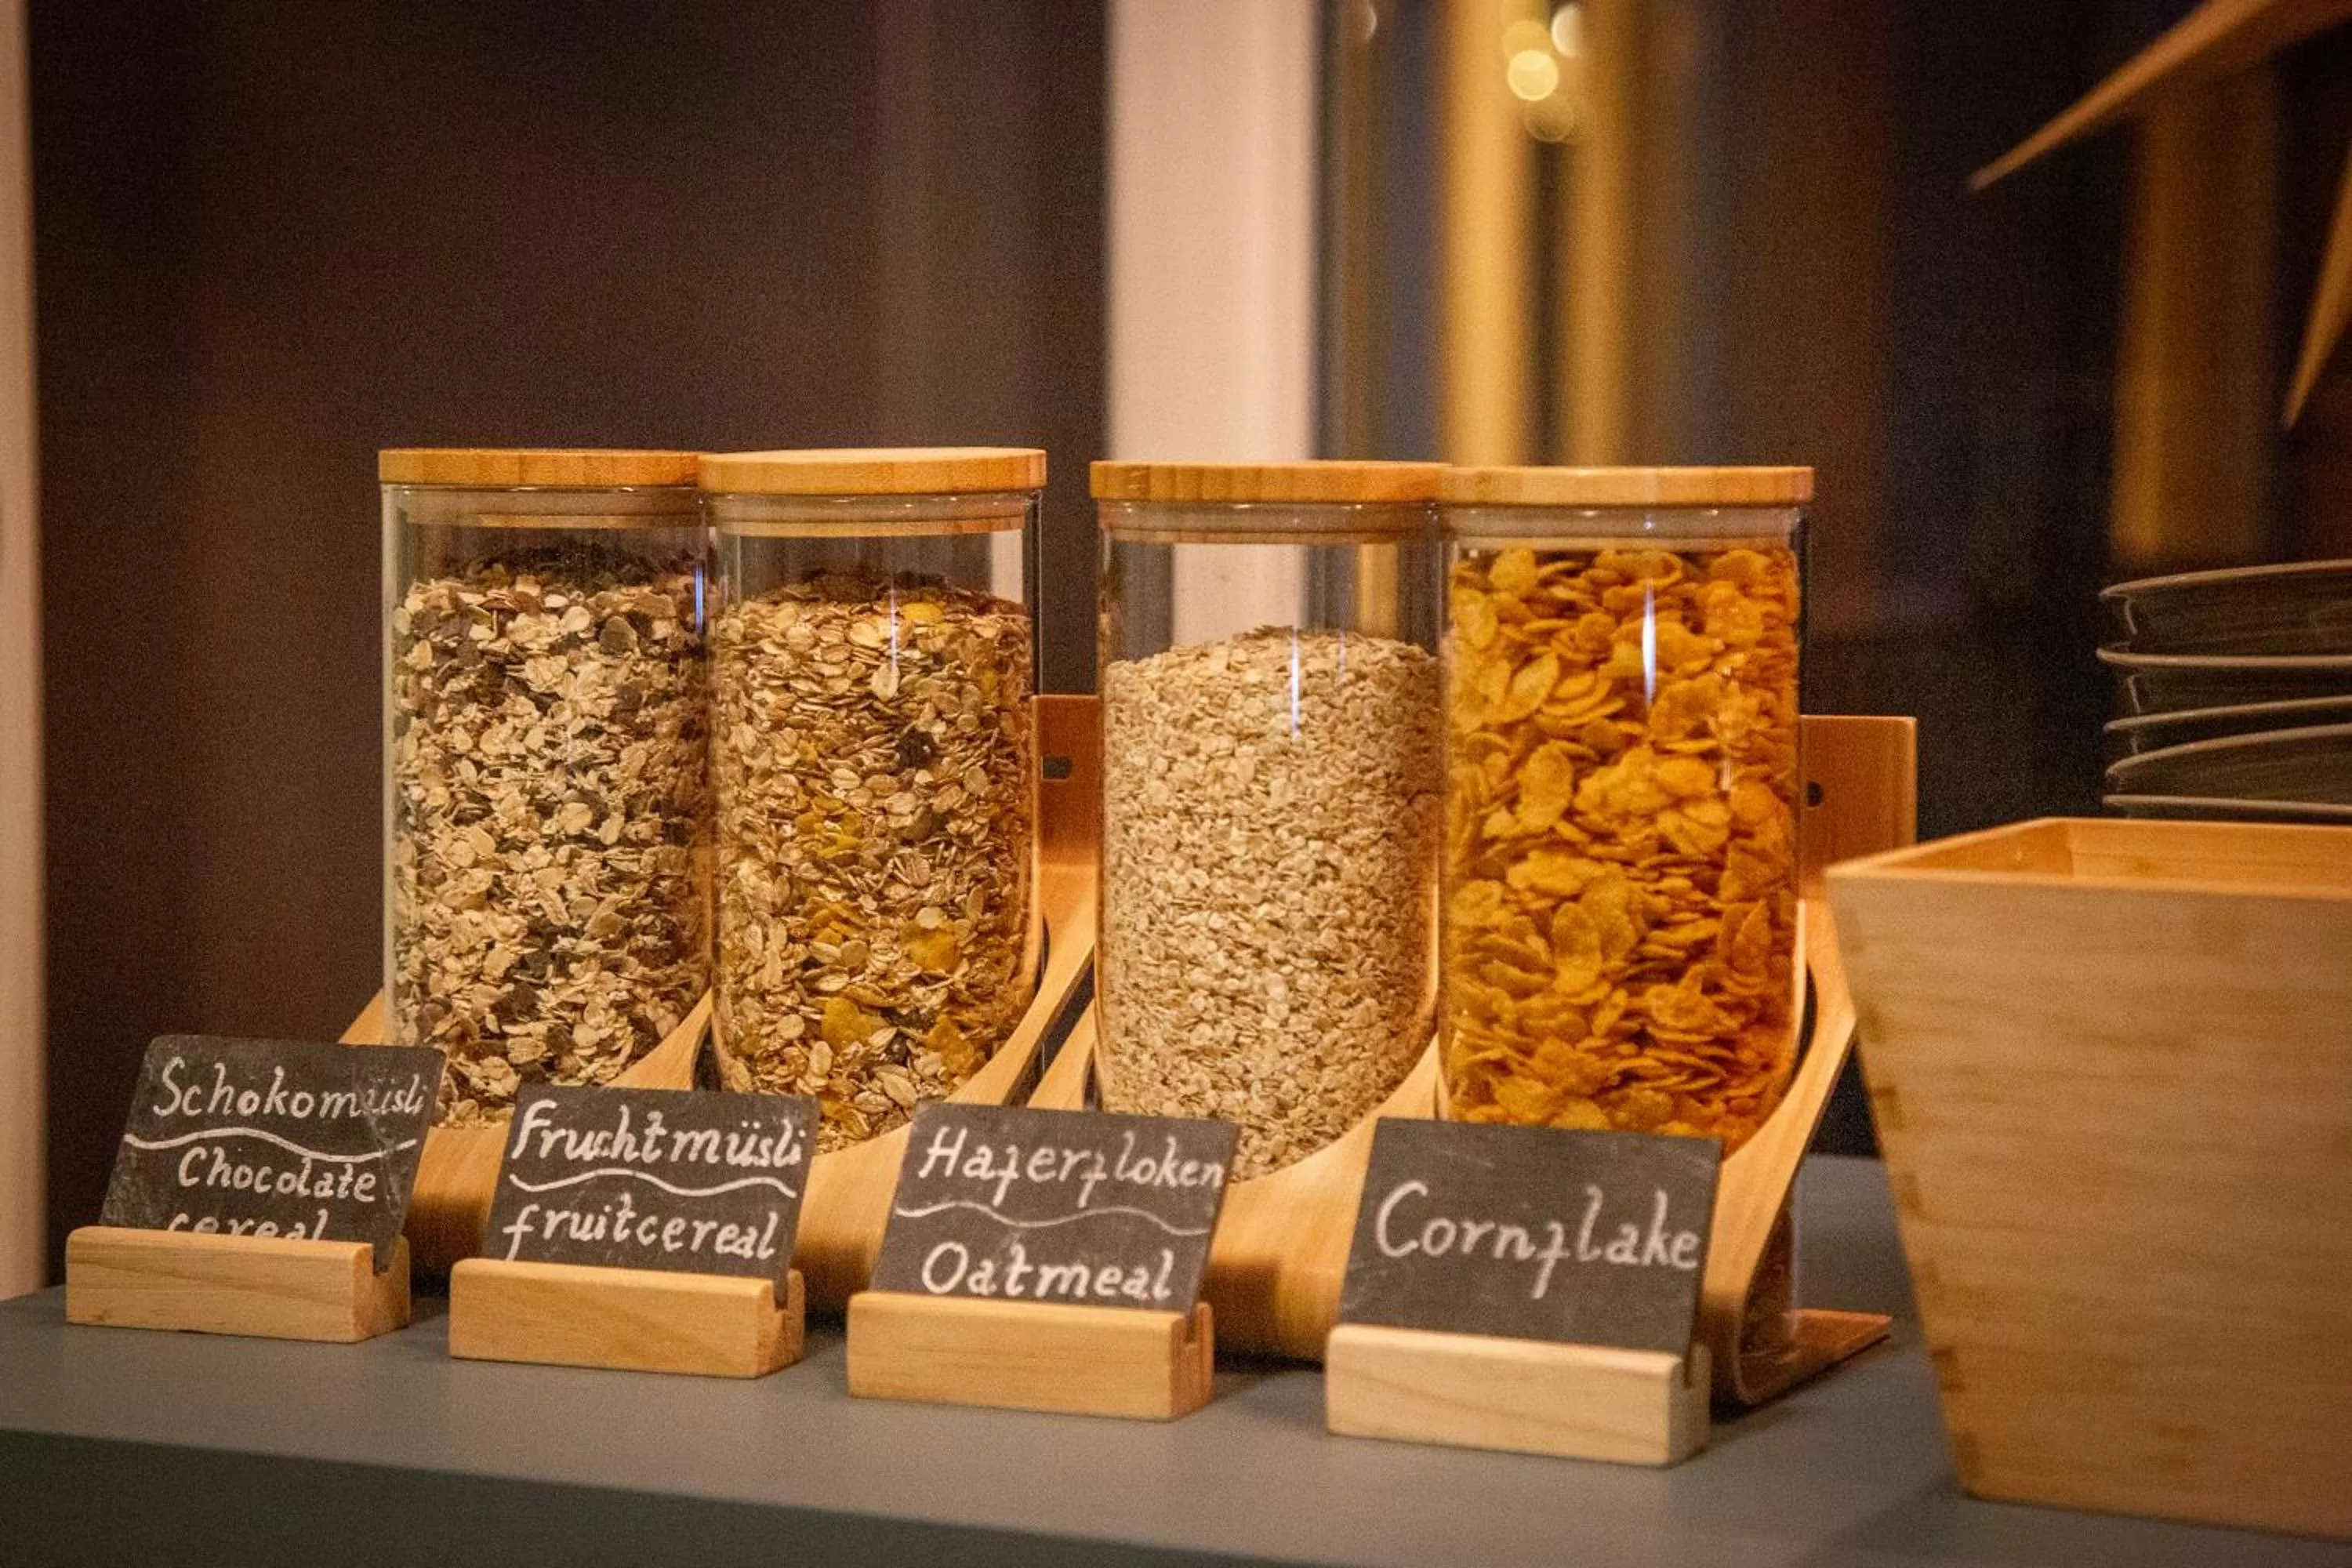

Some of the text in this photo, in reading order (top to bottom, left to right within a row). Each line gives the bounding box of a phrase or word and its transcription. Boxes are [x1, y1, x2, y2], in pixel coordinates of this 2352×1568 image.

[510, 1098, 807, 1167] Fruchtmüsli
[176, 1145, 376, 1203] Chocolate
[921, 1241, 1174, 1301] Oatmeal
[1375, 1179, 1700, 1301] Cornflake
